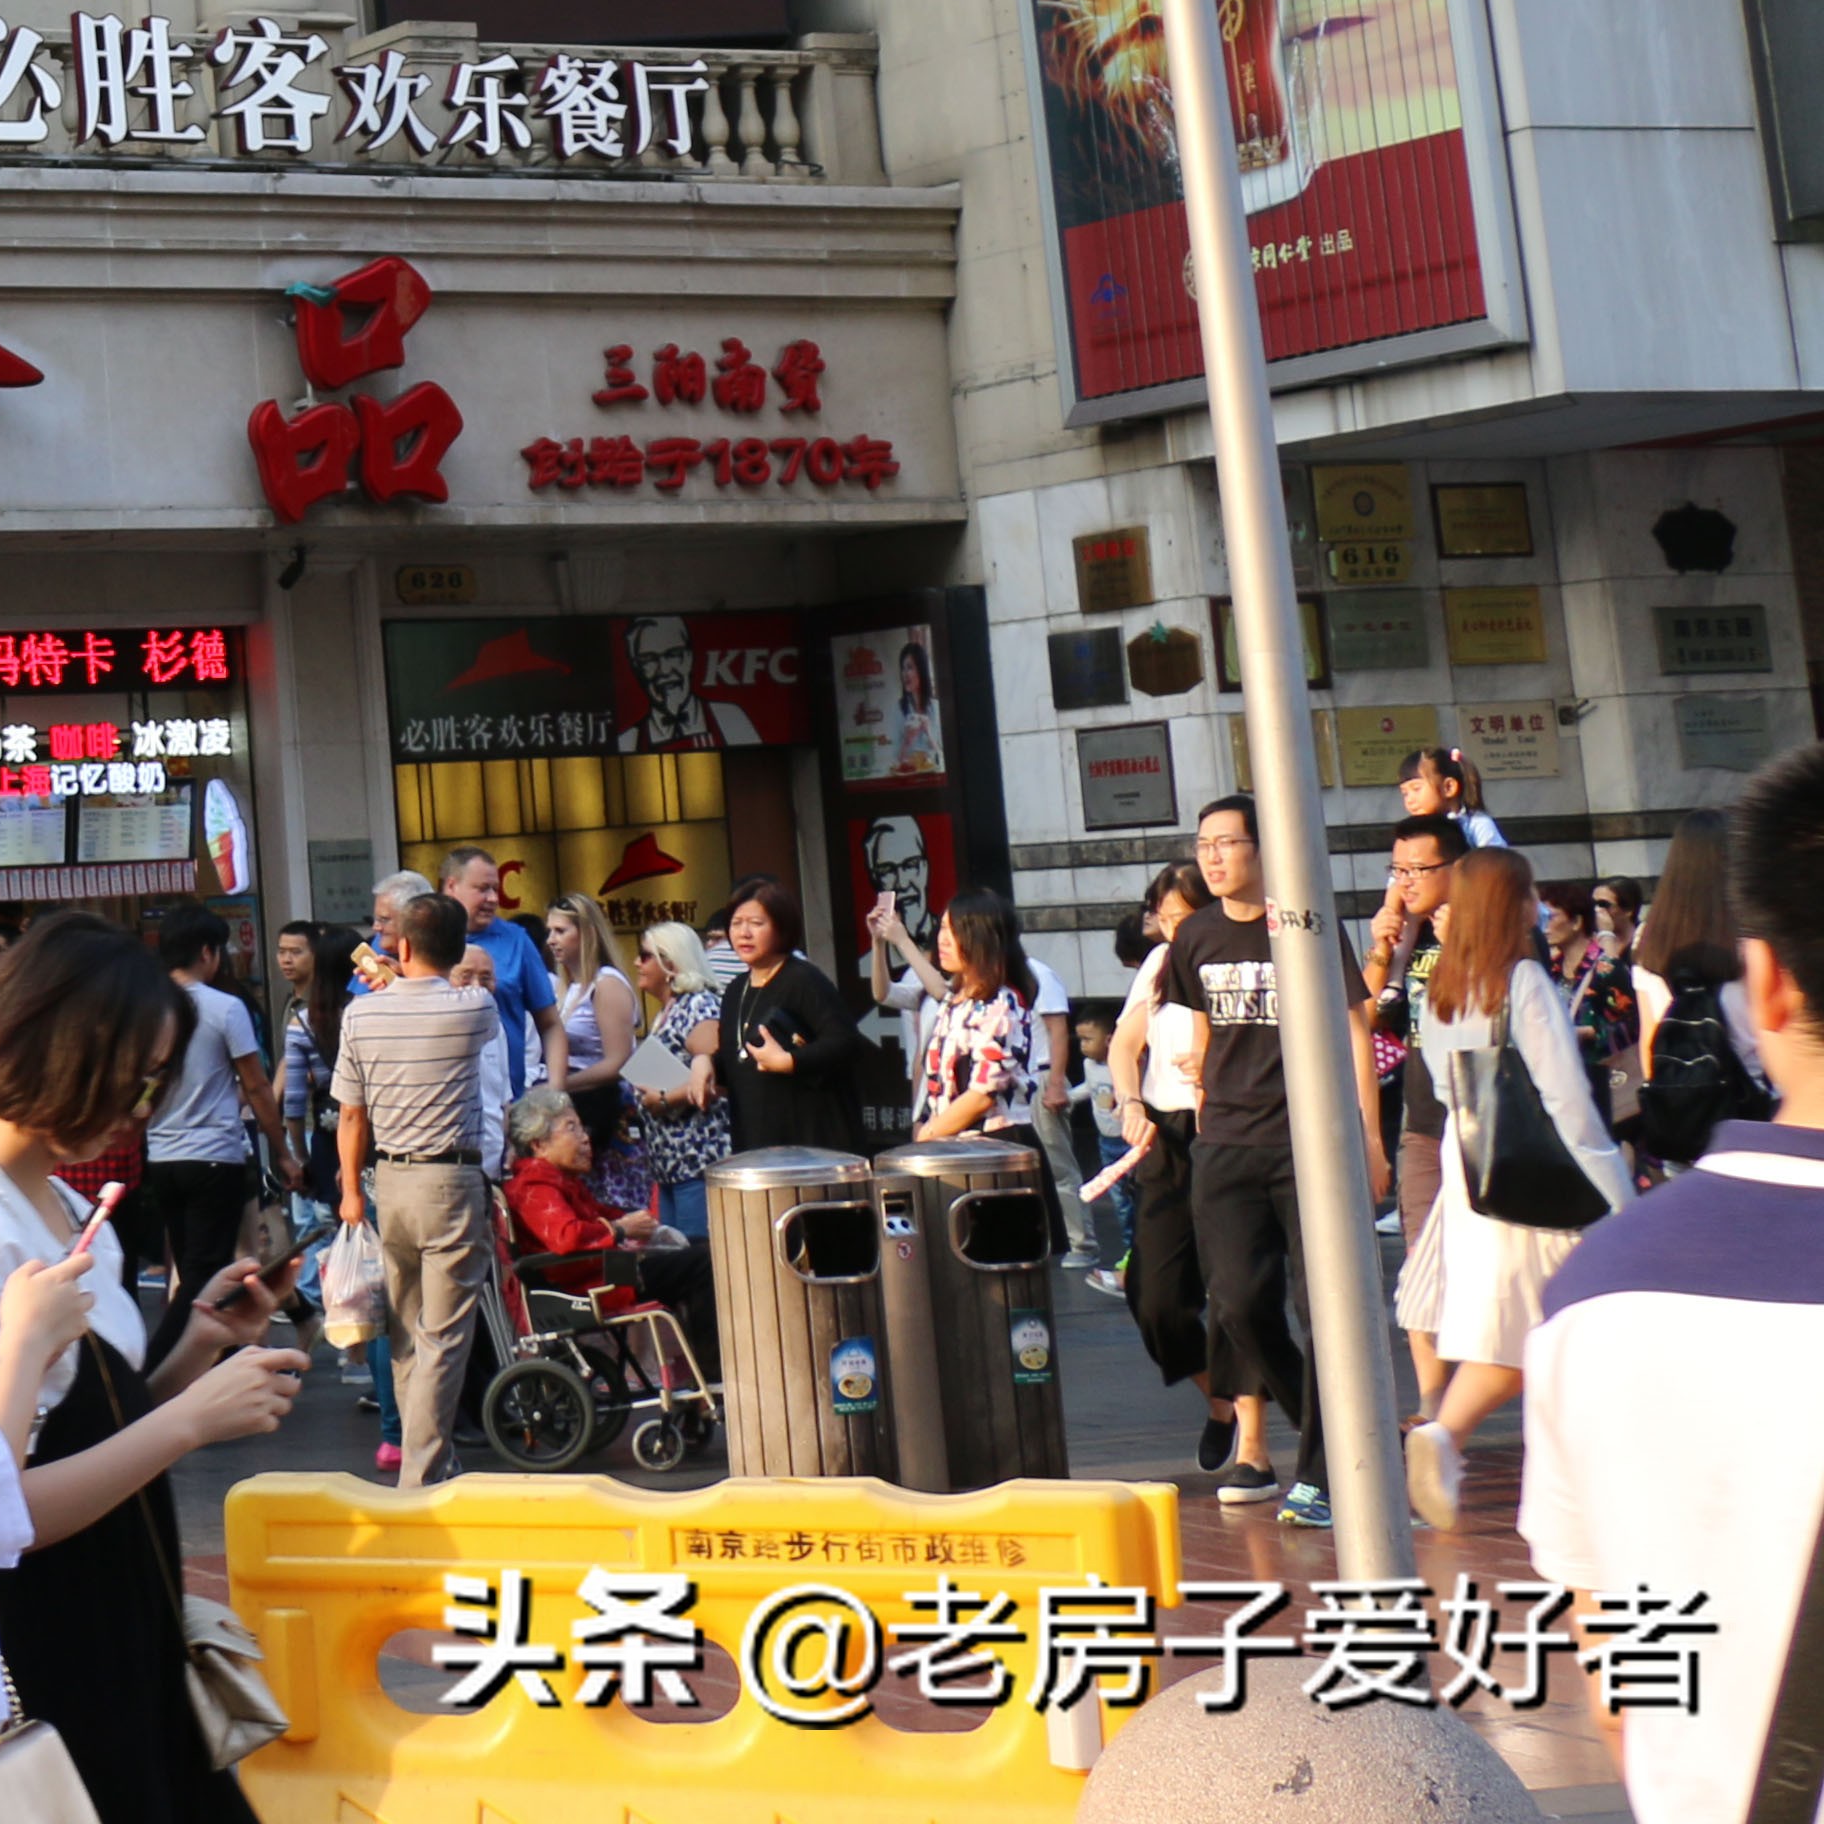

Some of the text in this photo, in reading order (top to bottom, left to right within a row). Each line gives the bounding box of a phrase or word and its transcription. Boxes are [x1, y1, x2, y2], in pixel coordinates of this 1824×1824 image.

[1318, 228, 1354, 256] 出品
[592, 337, 826, 413] 三阳南货
[522, 434, 901, 489] 创始于1870年
[1342, 546, 1400, 565] 616
[139, 628, 231, 685] 杉德
[701, 646, 801, 688] KFC
[47, 721, 121, 761] 咖啡
[131, 718, 231, 758] 冰激凌
[398, 708, 613, 754] 必胜客欢乐餐厅
[1469, 714, 1546, 735] 文明单位
[599, 897, 698, 927] 胜客欢乐餐厅
[685, 1528, 1028, 1569] 南京路步行街市政维修
